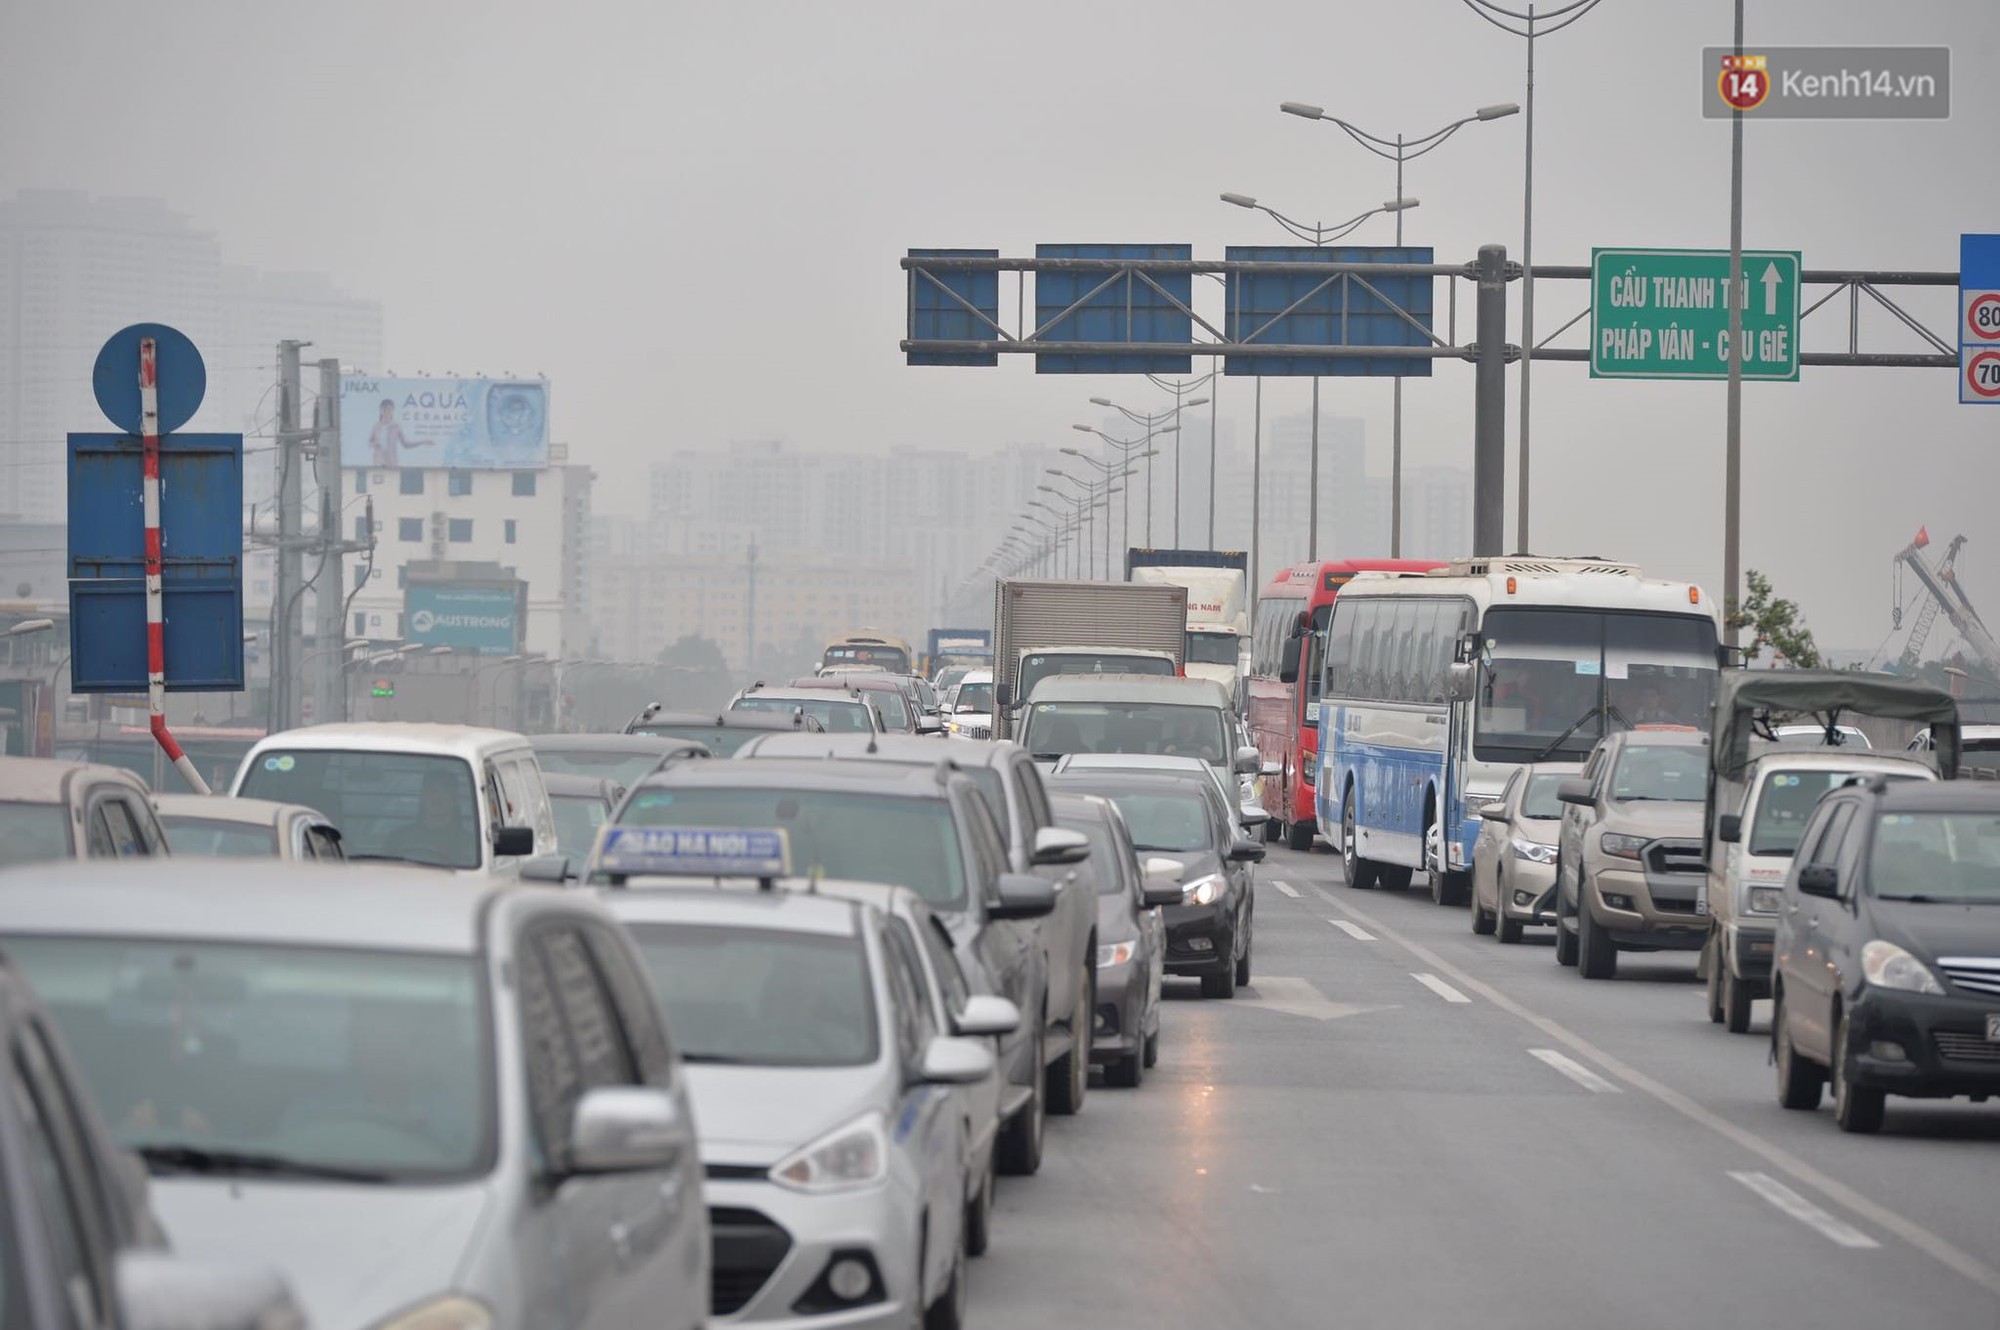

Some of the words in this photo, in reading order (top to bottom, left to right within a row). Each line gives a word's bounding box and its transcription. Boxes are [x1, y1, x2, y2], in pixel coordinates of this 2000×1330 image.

[1610, 265, 1647, 308] CẦU
[1653, 276, 1715, 309] THANH
[1720, 271, 1750, 310] TÌ
[1979, 306, 2000, 327] 80
[1602, 321, 1653, 360] PHÁP
[1658, 321, 1694, 361] VÂN
[1717, 321, 1754, 362] CU
[1759, 324, 1788, 362] GIẼ
[1978, 364, 2000, 384] 70
[345, 381, 380, 393] INAX
[403, 392, 468, 409] AQUA
[1201, 604, 1221, 612] NAM
[435, 614, 511, 628] AUSTRONG
